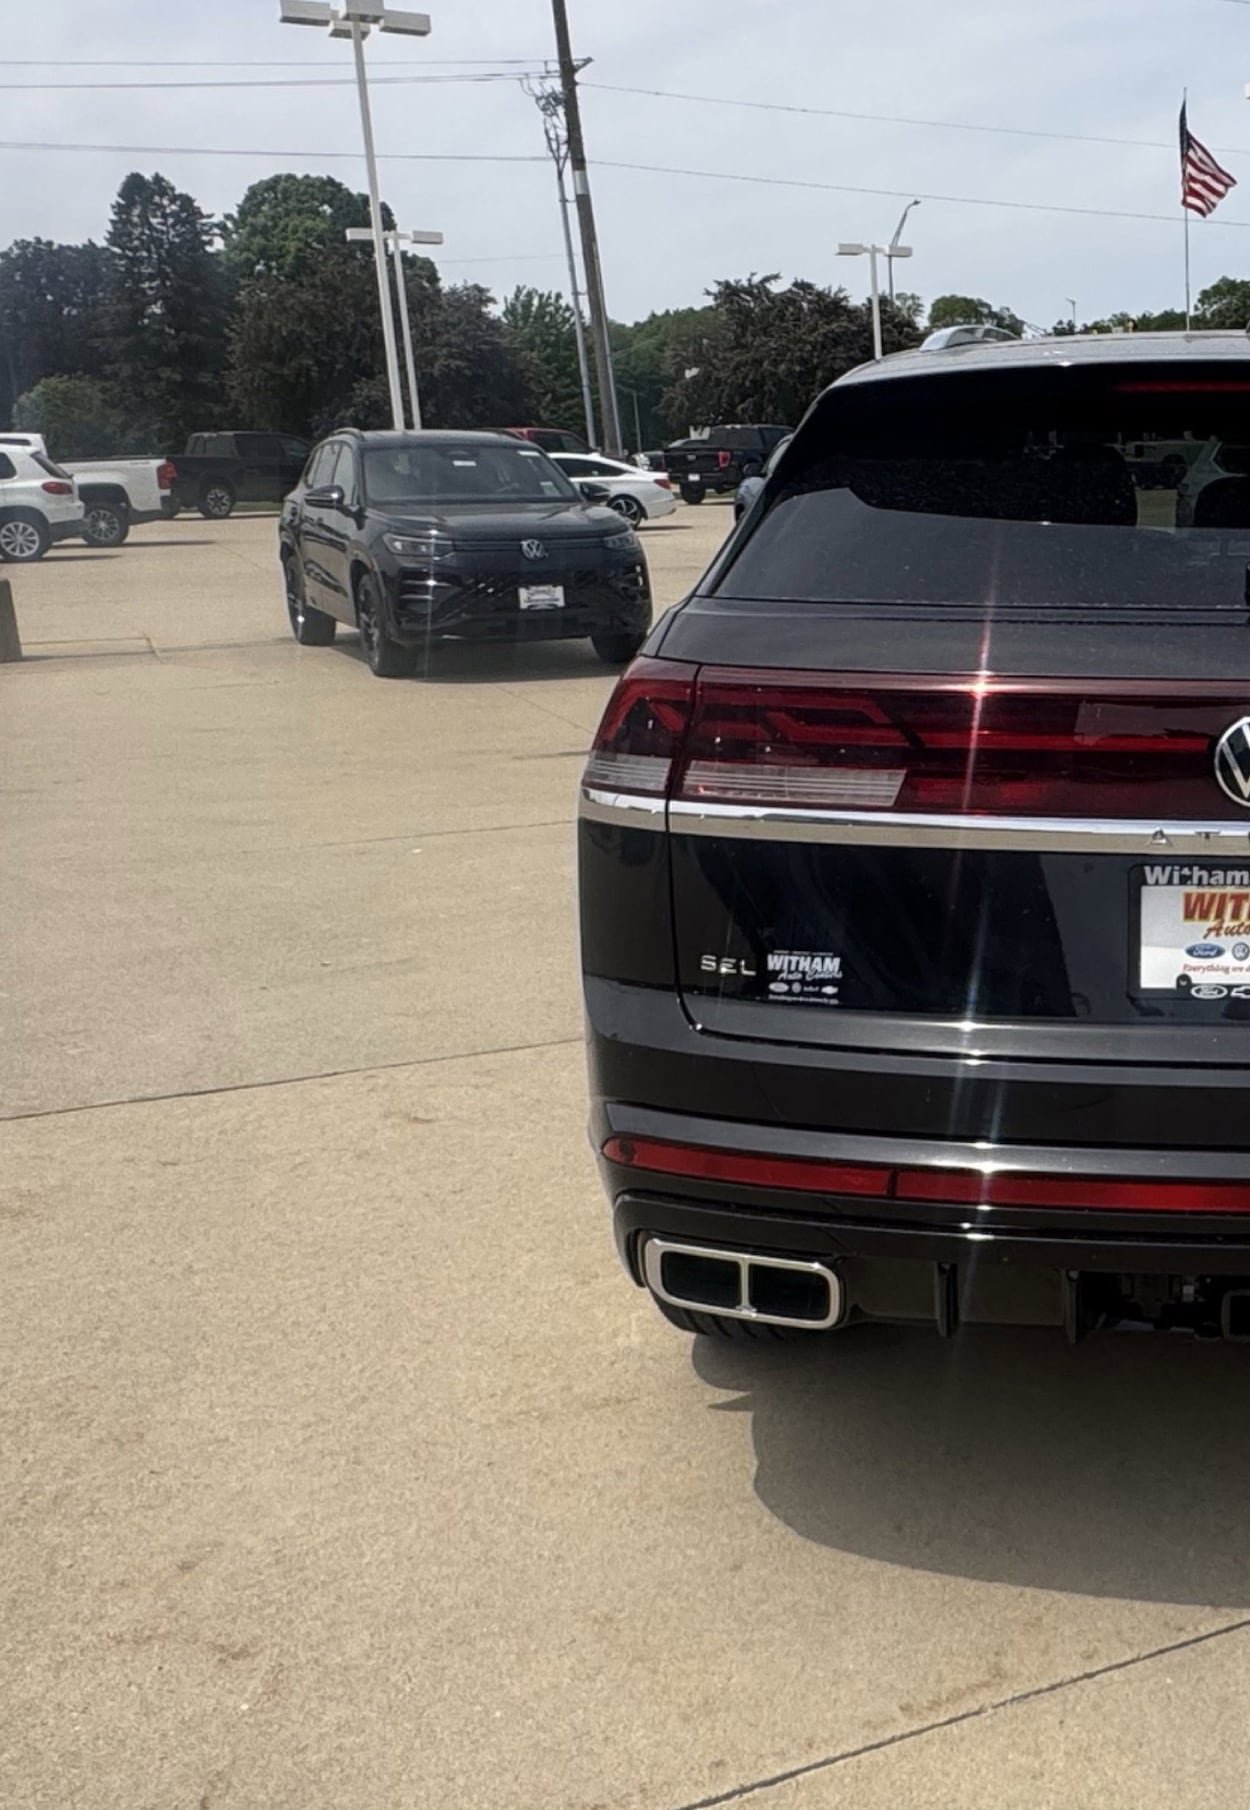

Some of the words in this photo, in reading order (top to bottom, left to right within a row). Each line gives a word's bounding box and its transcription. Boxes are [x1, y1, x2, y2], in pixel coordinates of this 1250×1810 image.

[701, 955, 757, 976] SEL
[767, 954, 841, 972] WITHAM
[1183, 964, 1230, 974] Everything
